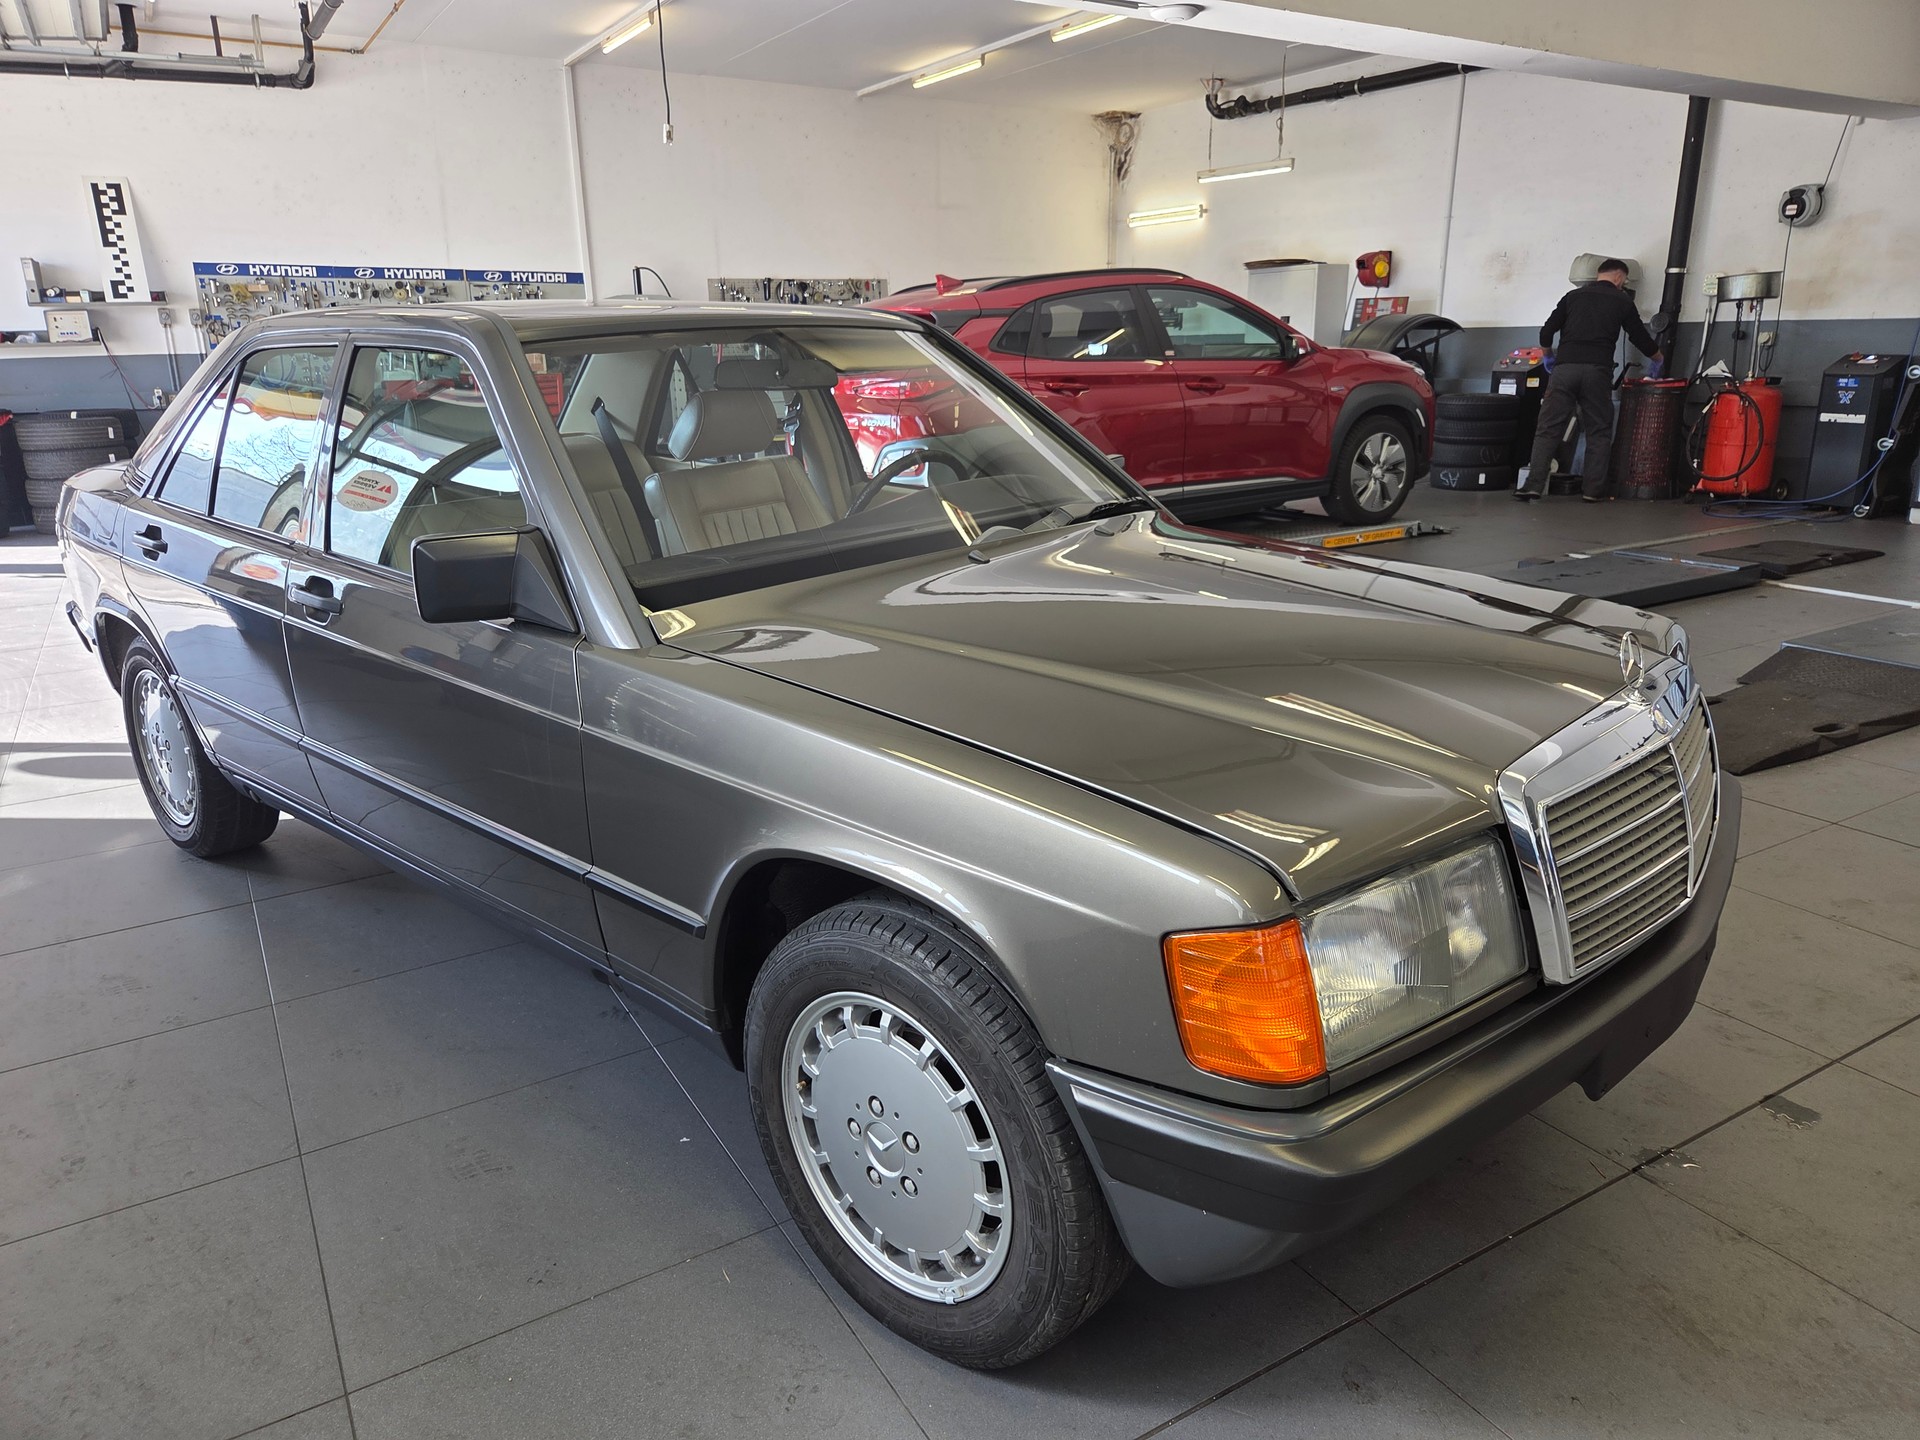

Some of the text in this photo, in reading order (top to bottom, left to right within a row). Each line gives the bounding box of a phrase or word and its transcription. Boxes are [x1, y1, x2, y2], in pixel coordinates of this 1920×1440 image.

[248, 264, 318, 277] HYUNDAI
[384, 268, 446, 280] HYUNDAI
[511, 272, 567, 283] HYUNDAI
[1333, 536, 1356, 545] CENTER
[1372, 531, 1394, 540] GRAVITY
[884, 966, 1047, 1313] GOODYEAR
